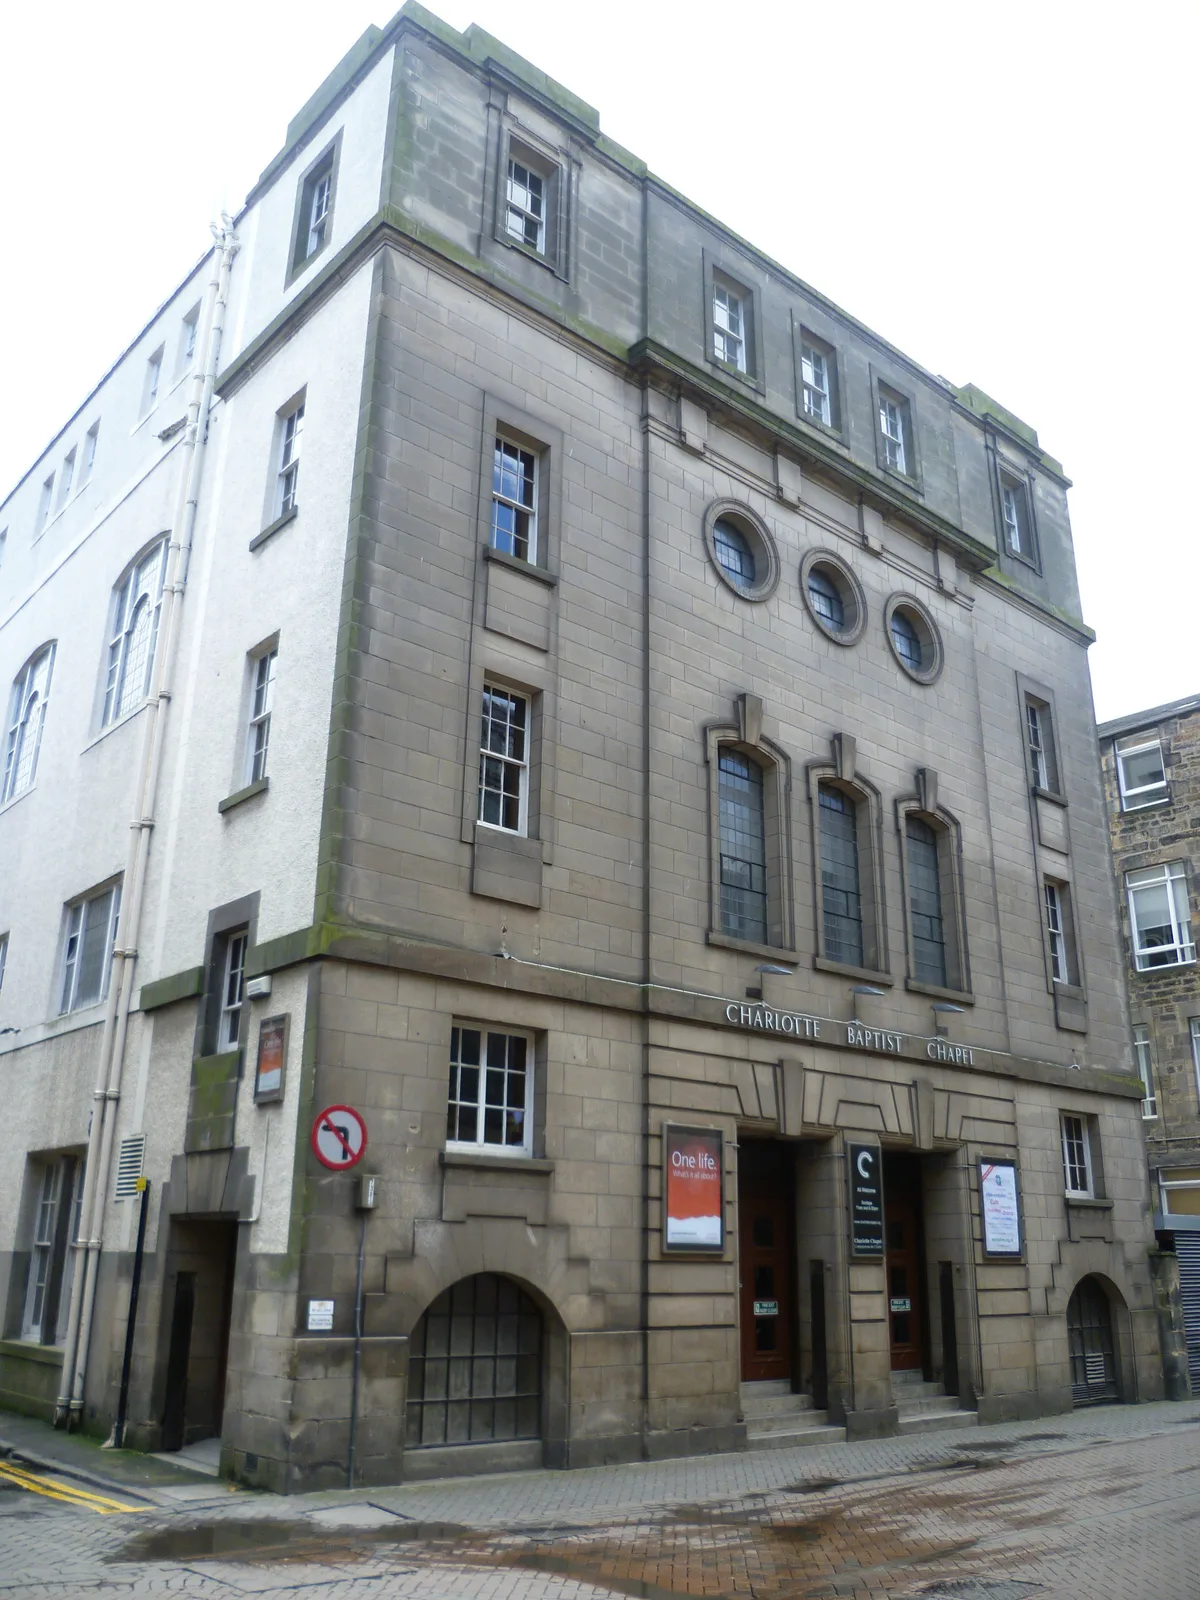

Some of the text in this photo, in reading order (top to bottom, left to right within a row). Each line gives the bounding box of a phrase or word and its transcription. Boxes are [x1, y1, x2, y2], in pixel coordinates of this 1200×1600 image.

[726, 1004, 976, 1066] CHARLOTTE BAPTIST CHAPEL
[672, 1151, 717, 1170] One life.
